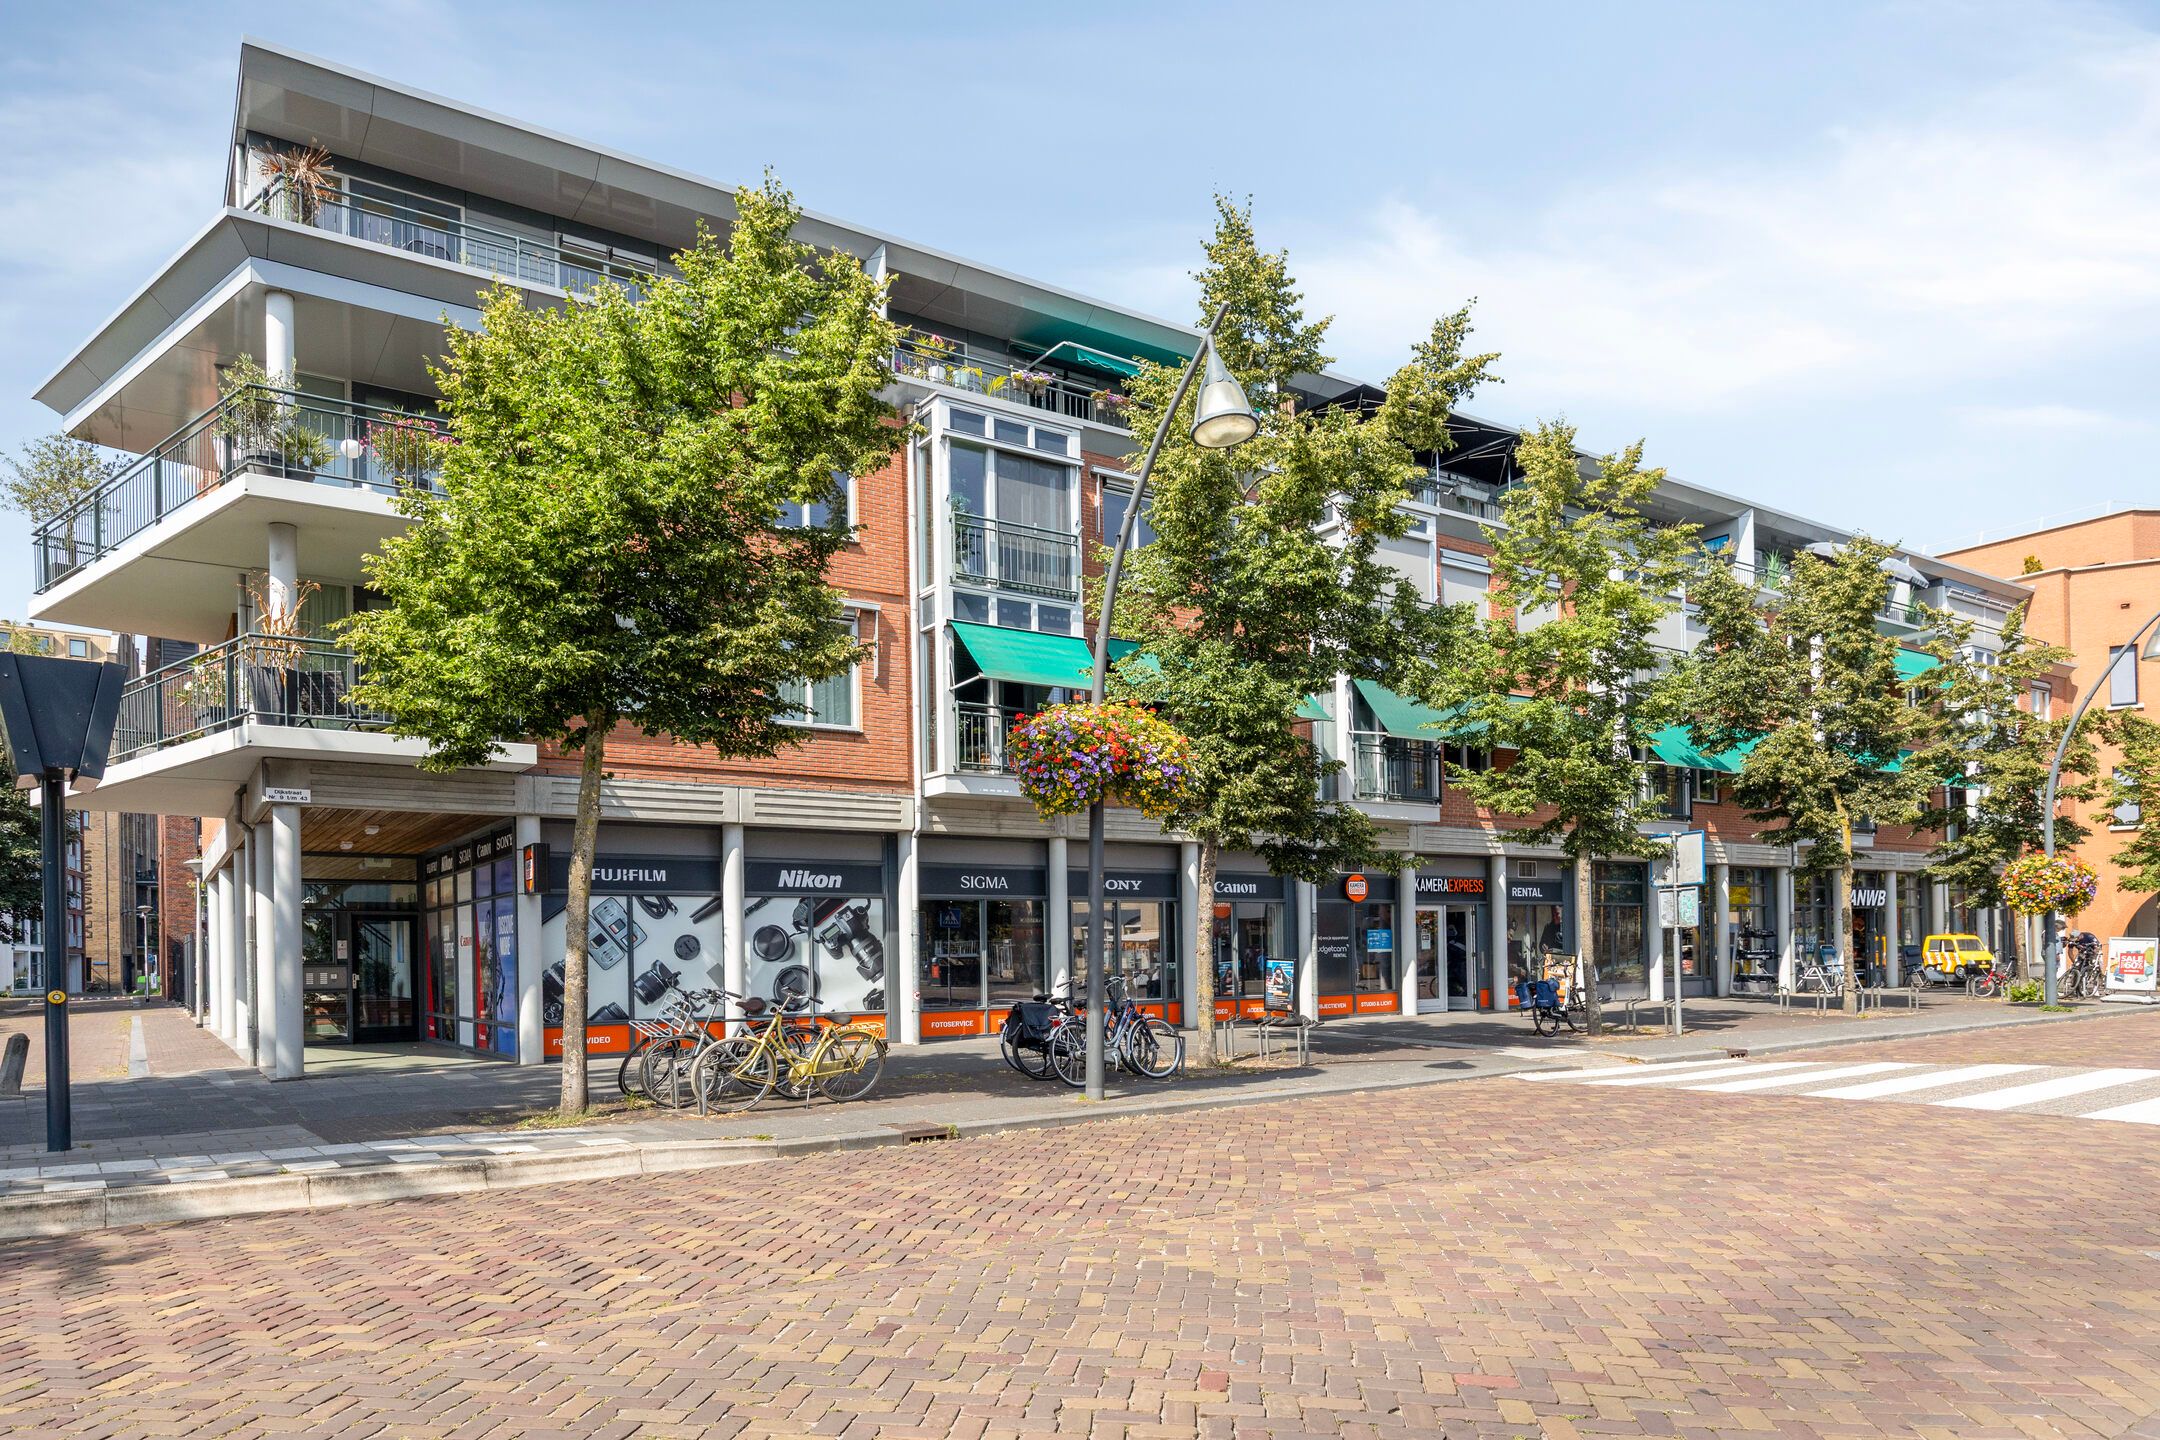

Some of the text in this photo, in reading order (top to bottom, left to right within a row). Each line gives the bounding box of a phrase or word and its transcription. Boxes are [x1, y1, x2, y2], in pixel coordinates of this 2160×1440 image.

[591, 868, 667, 882] FUJIFILM
[778, 870, 842, 888] Nikon
[960, 875, 1009, 889] SIGMA
[1103, 879, 1143, 891] ONY
[1213, 881, 1257, 894] Canon
[1511, 887, 1543, 897] RENTAL
[1850, 889, 1887, 907] ANWB
[931, 1020, 974, 1028] FOTOSERVICE
[586, 1036, 611, 1044] VIDEO
